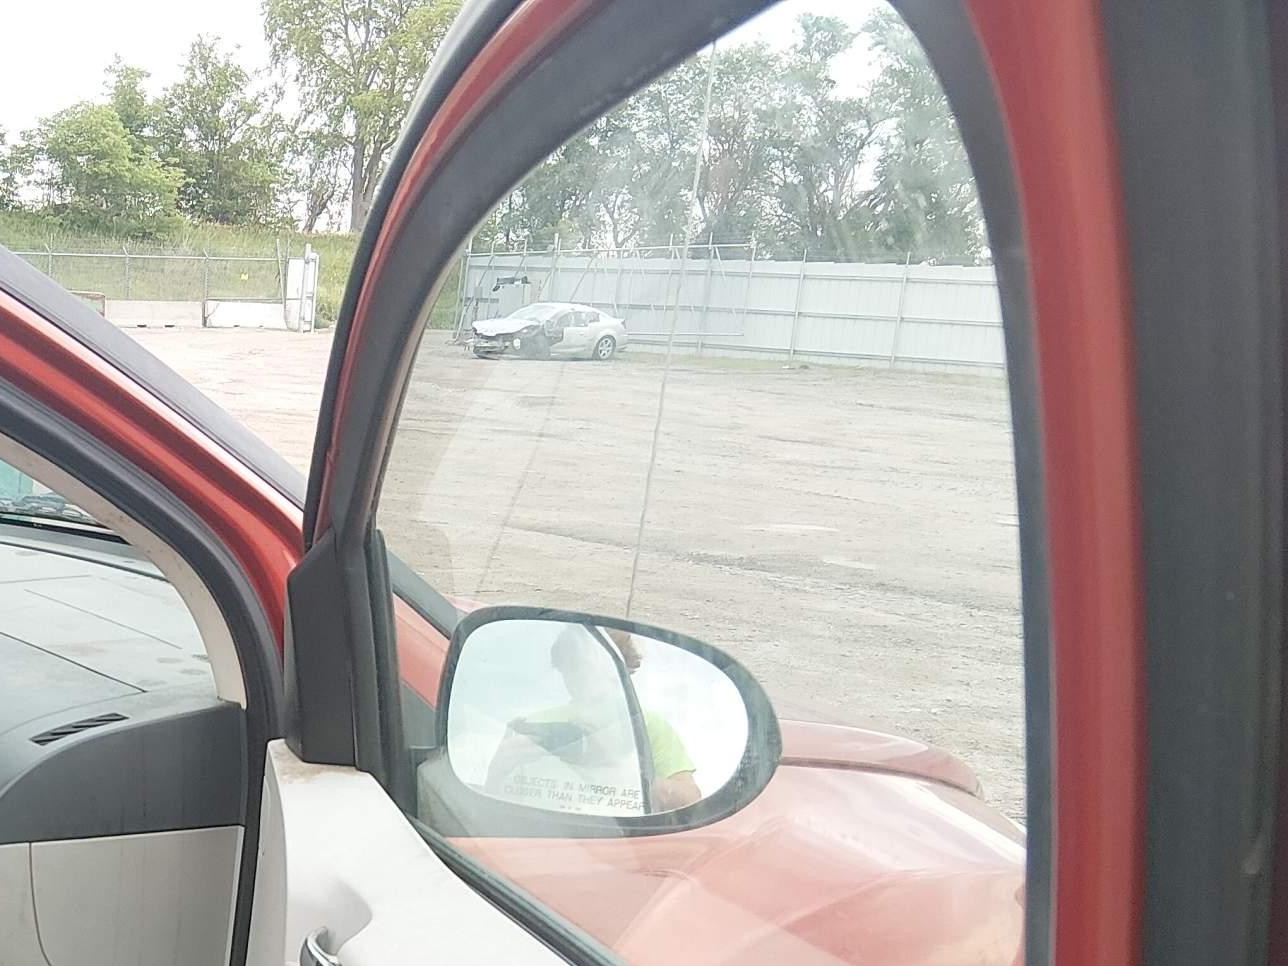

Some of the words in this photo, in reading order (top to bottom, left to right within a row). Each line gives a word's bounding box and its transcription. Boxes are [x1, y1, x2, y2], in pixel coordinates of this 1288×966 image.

[547, 789, 573, 802] THAN
[578, 793, 602, 806] THEY
[564, 781, 574, 791] IN
[579, 783, 616, 796] MIRROR
[622, 788, 641, 800] ARE
